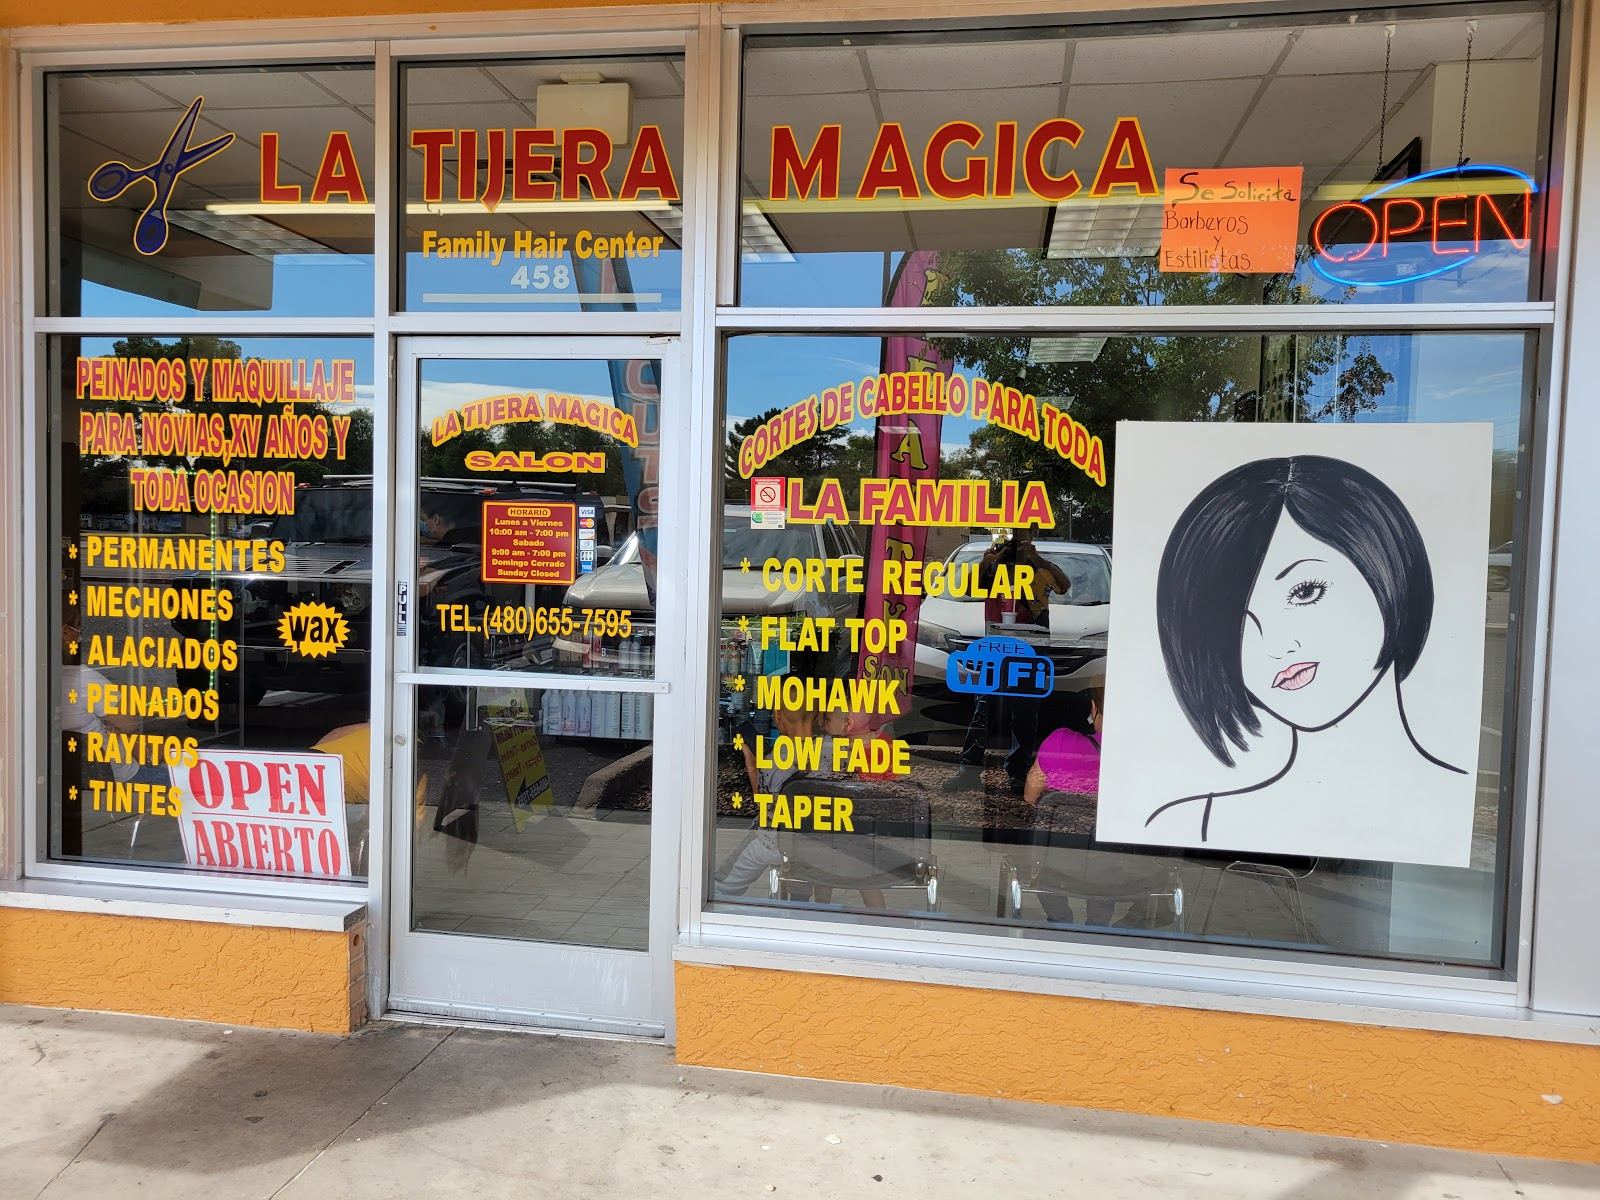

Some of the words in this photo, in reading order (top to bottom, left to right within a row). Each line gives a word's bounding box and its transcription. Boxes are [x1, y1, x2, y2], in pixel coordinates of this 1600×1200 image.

[261, 131, 368, 204] LA
[411, 125, 680, 213] TIJERA
[769, 116, 1160, 201] MAGICA
[1171, 171, 1214, 208] Se
[1219, 177, 1296, 203] Solicita
[1162, 210, 1249, 235] Barberos
[1313, 187, 1531, 263] OPEN
[422, 230, 506, 266] Family
[514, 230, 568, 259] Hair
[575, 229, 664, 259] Center
[510, 264, 570, 290] 458
[76, 356, 186, 402] PEINADOS
[190, 358, 209, 402] Y
[211, 358, 355, 407] MAQUILLAJE
[79, 411, 139, 456] PARA
[263, 402, 329, 460] AÑOS
[332, 415, 351, 460] Y
[432, 409, 462, 447] LA
[463, 392, 544, 430] TIJERA
[545, 393, 639, 448] MAGICA
[738, 394, 818, 480] CORTES
[819, 380, 855, 432] DE
[857, 371, 969, 420] CABELLO
[971, 377, 1041, 442] PARA
[1041, 402, 1106, 488] TODA
[464, 450, 606, 474] SALON
[130, 467, 192, 513] TODA
[194, 469, 295, 515] OCASION
[786, 477, 850, 526] LA
[859, 478, 1056, 529] FAMILIA
[489, 528, 513, 536] 10:00
[534, 529, 554, 537] 7:00
[555, 530, 569, 538] pm
[495, 518, 520, 526] Lunes
[530, 518, 564, 527] Viernes
[87, 535, 286, 573] PERMANENTES
[491, 548, 510, 556] 9:00
[532, 549, 551, 557] 7:00
[512, 539, 545, 547] Sabado
[491, 558, 529, 567] Domingo
[530, 559, 566, 568] Cerrado
[497, 568, 529, 577] Sunday
[530, 569, 560, 578] Closed
[762, 557, 865, 593] CORTE
[882, 558, 1035, 601] REGULAR
[87, 585, 234, 622] MECHONES
[398, 584, 407, 624] PULL
[87, 635, 238, 672] ALACIADOS
[761, 616, 836, 653] FLAT
[844, 617, 908, 654] TOP
[978, 642, 1025, 655] FREE
[87, 682, 220, 721] PEINADOS
[757, 675, 901, 715] MOHAWK
[87, 732, 200, 769] RAYITOS
[755, 734, 823, 772] LOW
[831, 737, 911, 775] FADE
[89, 780, 183, 818] TINTES
[188, 758, 328, 817] OPEN
[753, 793, 854, 832] TAPER
[192, 819, 341, 876] ABIERTO
